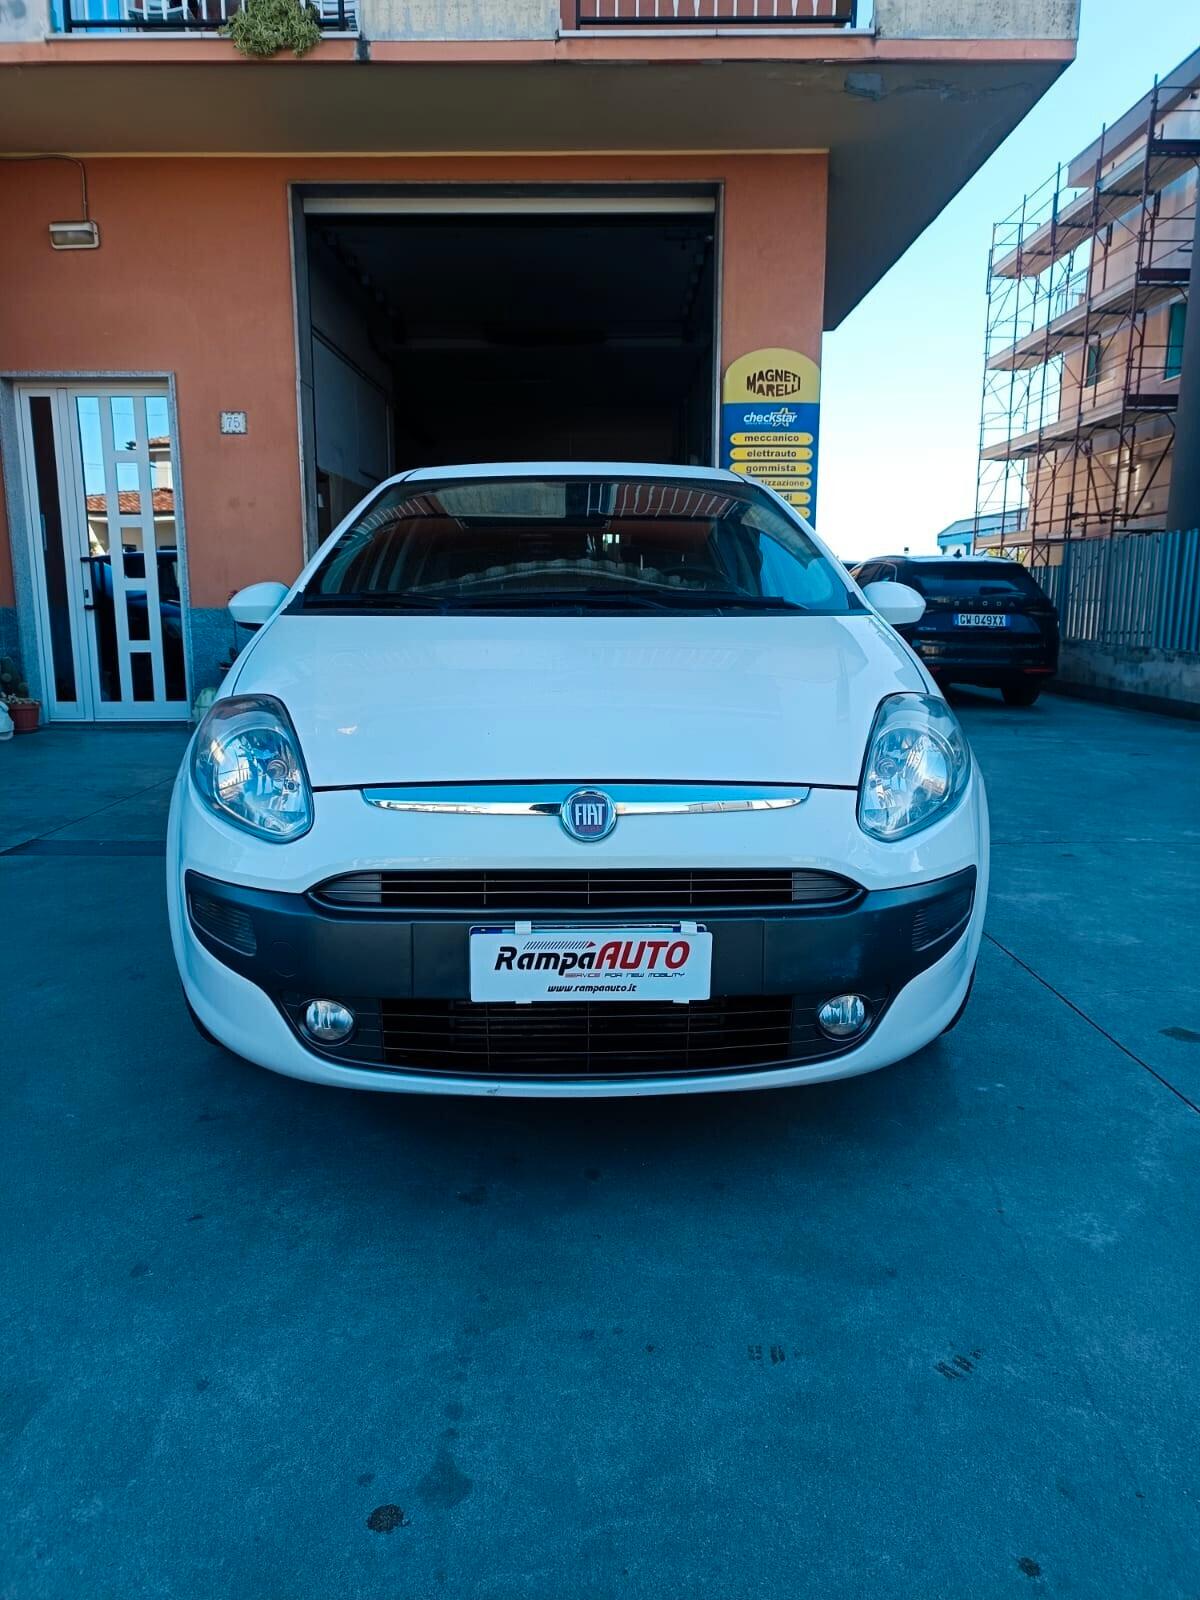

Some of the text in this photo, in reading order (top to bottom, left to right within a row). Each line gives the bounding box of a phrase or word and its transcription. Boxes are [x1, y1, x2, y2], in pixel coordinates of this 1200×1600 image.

[746, 369, 801, 392] MAGNETI
[746, 376, 801, 397] MARELLI
[226, 416, 241, 429] 75
[743, 411, 798, 423] checkstar
[744, 434, 800, 442] meccanico
[746, 449, 797, 458] elettrauto
[746, 465, 797, 474] gommista
[974, 615, 1005, 627] 049XX
[575, 803, 605, 826] FIAT
[494, 941, 690, 976] RampaAUTO
[547, 983, 637, 994] www.rampaauto.it
